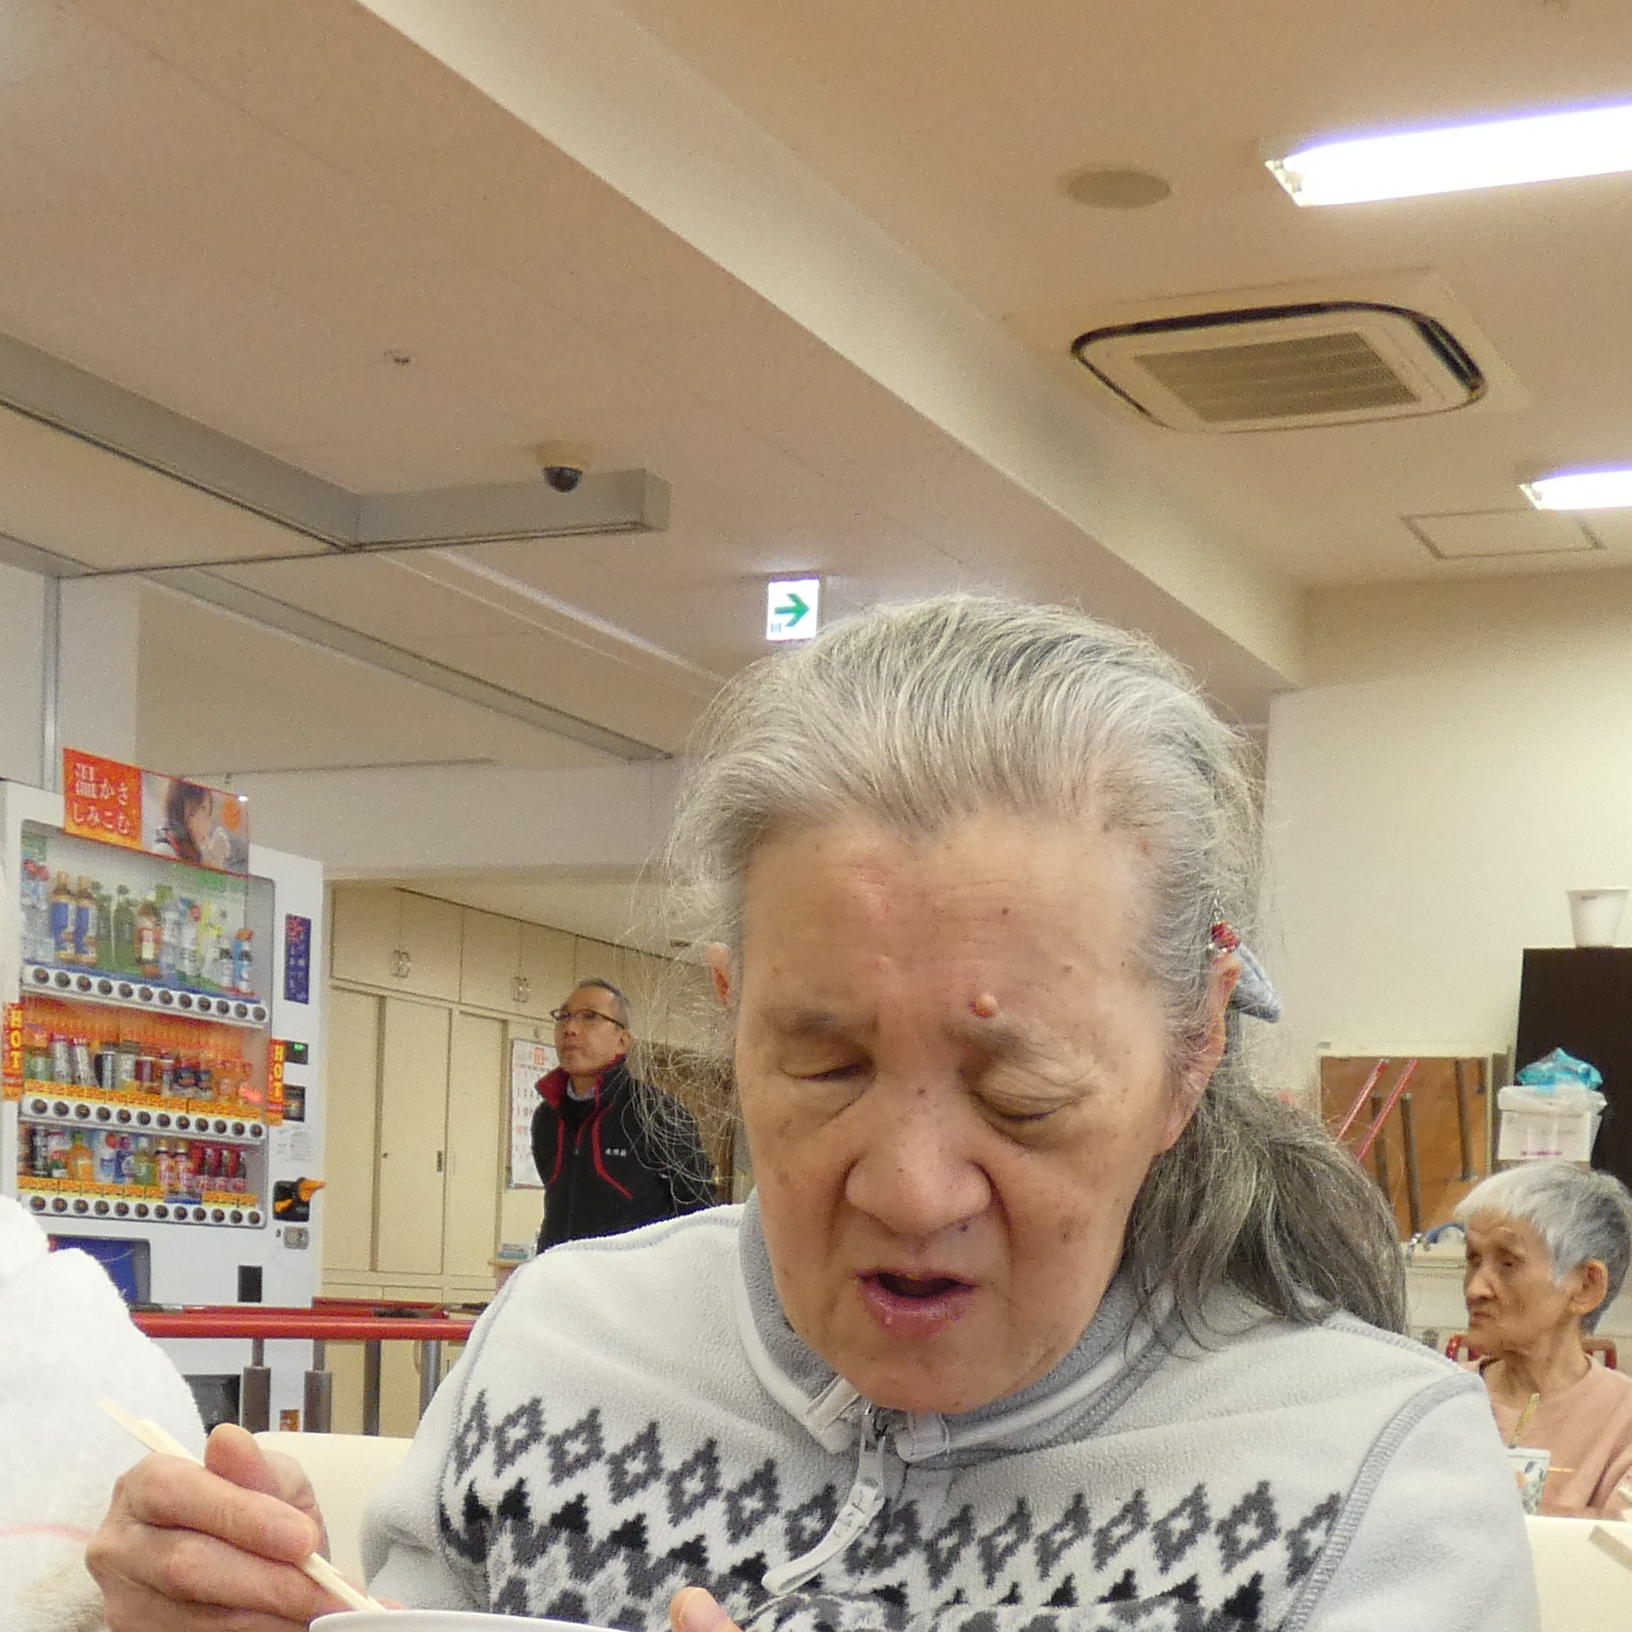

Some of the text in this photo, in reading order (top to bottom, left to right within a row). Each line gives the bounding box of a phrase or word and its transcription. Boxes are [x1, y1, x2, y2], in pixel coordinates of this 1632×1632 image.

[74, 763, 130, 806] 温かさ
[72, 801, 131, 835] しみこむ
[10, 1009, 23, 1069] HOT
[273, 1045, 284, 1099] HOT
